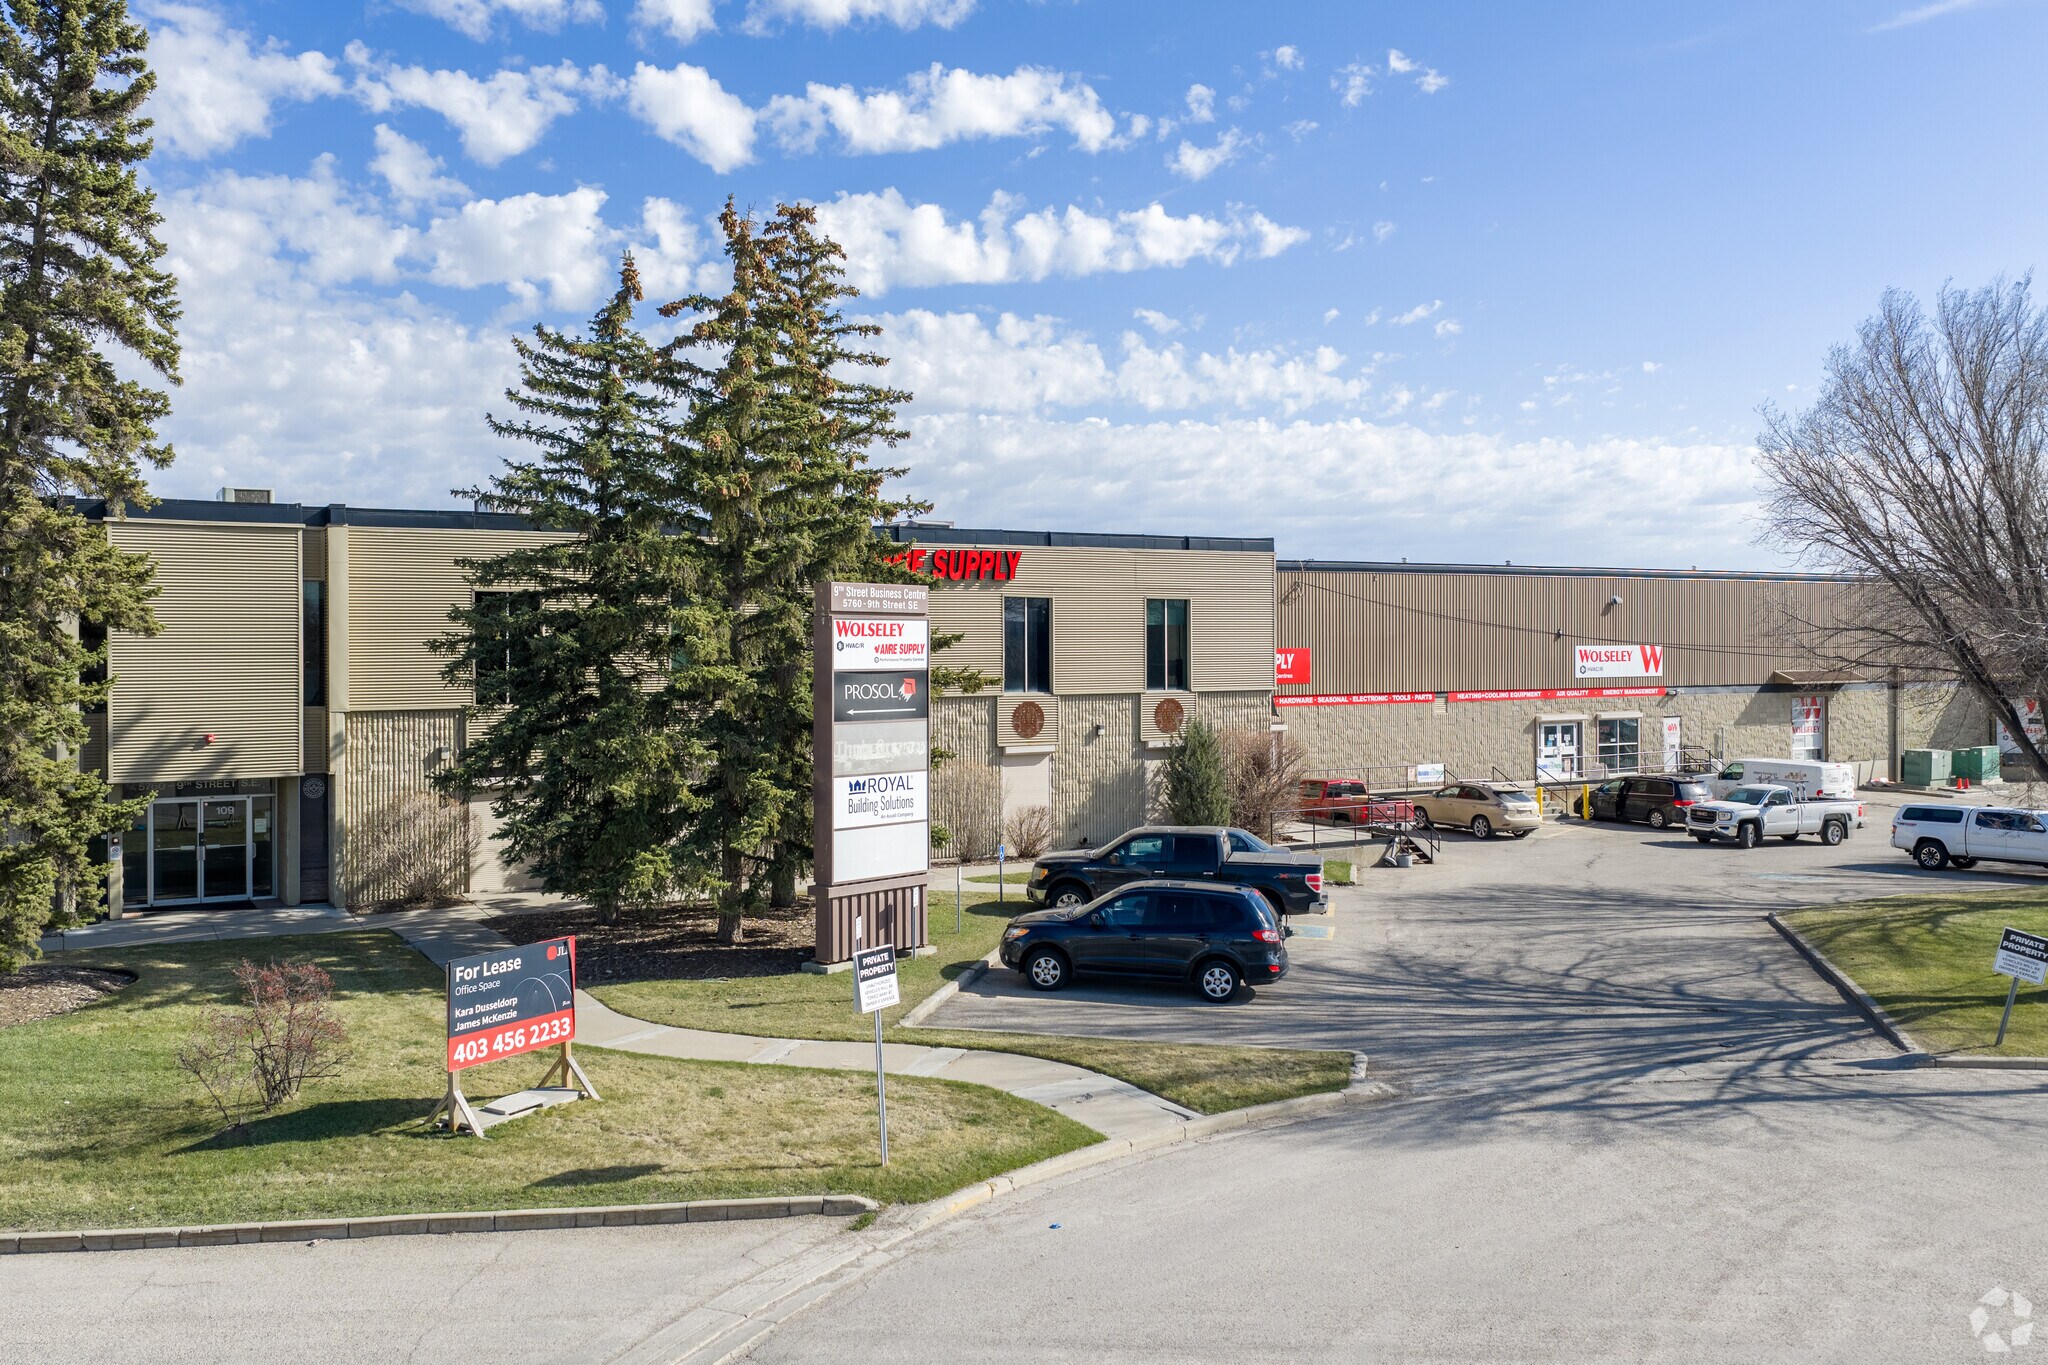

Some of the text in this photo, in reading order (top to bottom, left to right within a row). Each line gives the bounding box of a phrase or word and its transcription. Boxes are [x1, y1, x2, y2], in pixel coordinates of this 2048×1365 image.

[932, 549, 1022, 581] SUPPLY
[846, 586, 868, 598] Street
[870, 588, 902, 599] Business
[904, 589, 926, 600] Centre
[843, 600, 862, 608] 5760
[868, 600, 880, 608] 9th
[882, 600, 906, 609] Street
[908, 601, 918, 610] SE
[836, 621, 904, 637] WOLSELEY
[880, 644, 925, 654] AMRE SUPPLY
[1579, 650, 1633, 663] WOLSELEY
[844, 683, 898, 700] PROSOL
[176, 781, 192, 790] 9TH
[196, 780, 236, 789] STREET
[868, 775, 914, 793] ROYAL
[216, 806, 234, 815] 109
[848, 795, 914, 816] Building Solutions
[2002, 941, 2048, 959] PROPERTY
[2010, 934, 2045, 950] PRIVATE
[863, 952, 889, 966] PRIVATE
[2002, 957, 2022, 966] VEHICLES
[2006, 954, 2039, 966] UNAUTHORIZED
[456, 958, 521, 982] For Lease
[860, 962, 894, 978] PROPERTY
[2019, 971, 2039, 980] EXPENSE
[455, 980, 500, 995] Office Space
[455, 997, 518, 1018] Kara Dusseldorp
[455, 1009, 517, 1031] James McKenzie
[453, 1018, 570, 1062] 403 456 2233
